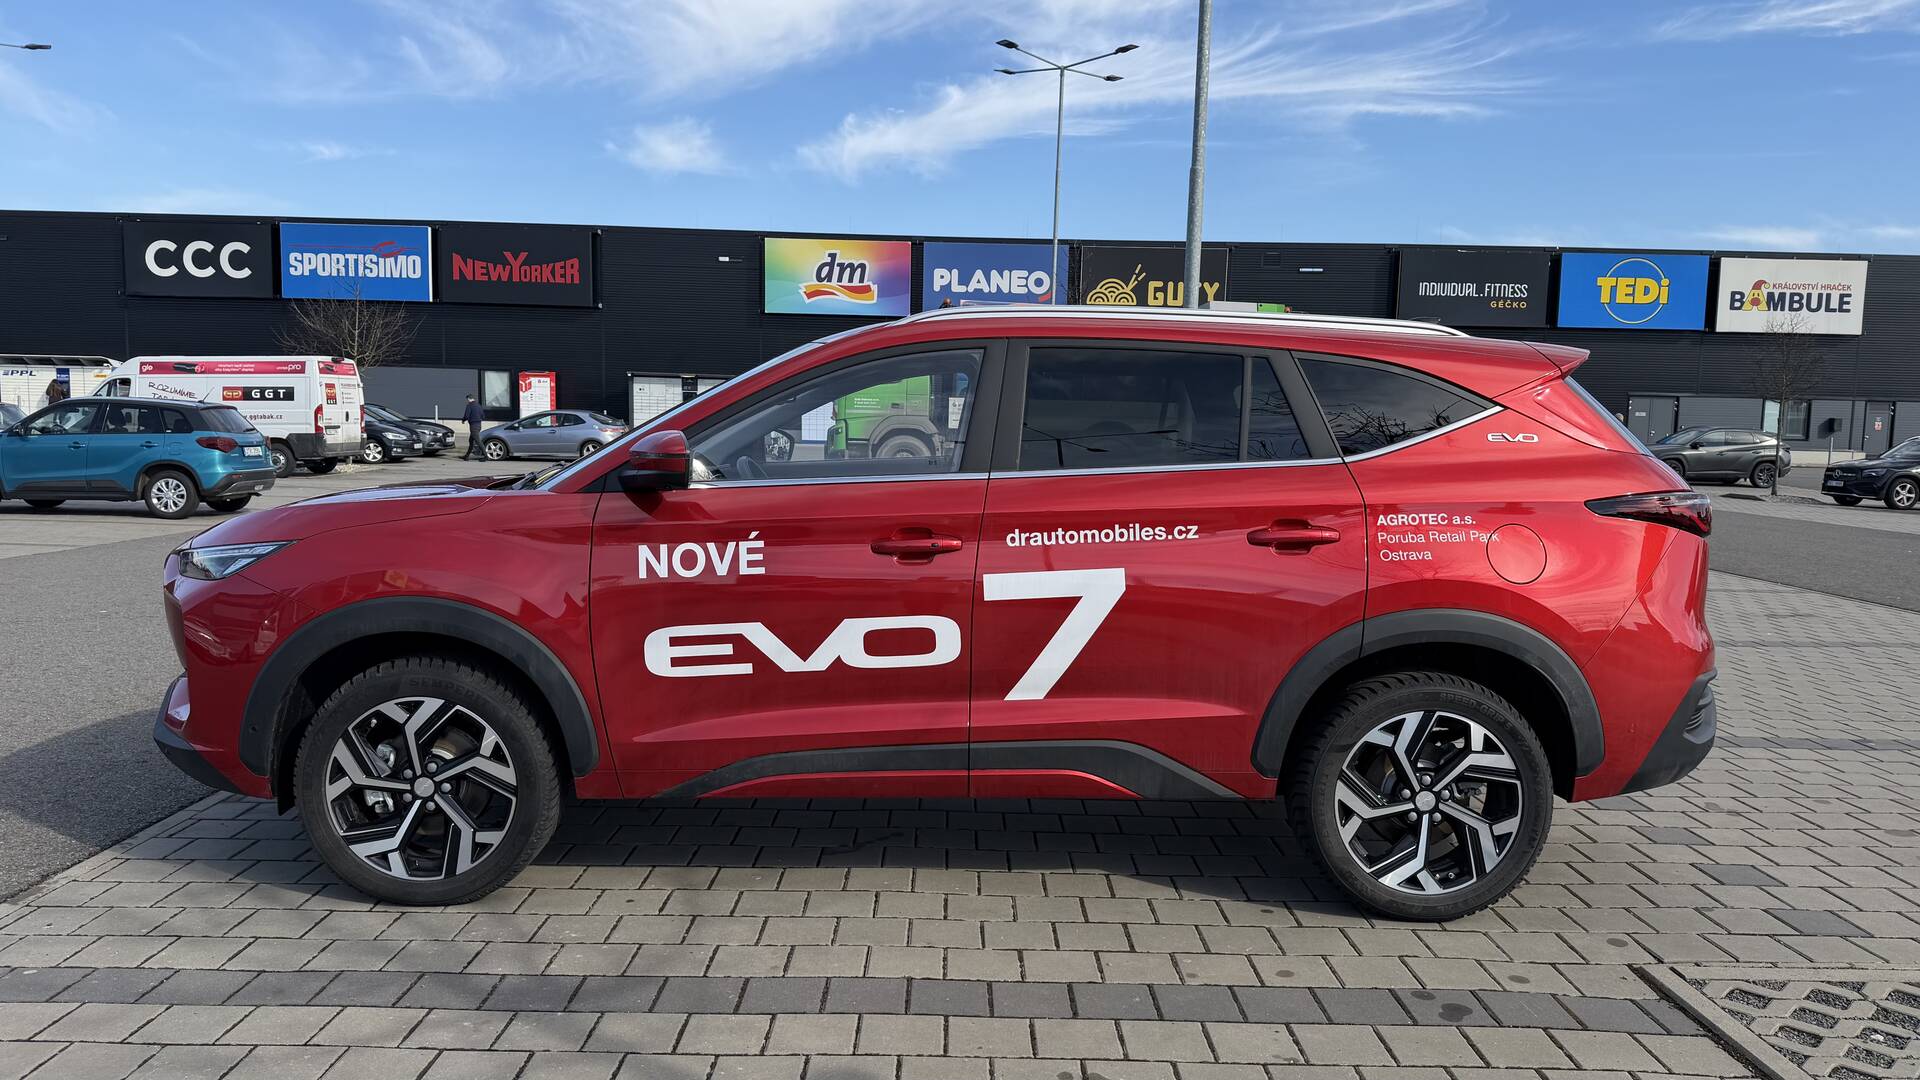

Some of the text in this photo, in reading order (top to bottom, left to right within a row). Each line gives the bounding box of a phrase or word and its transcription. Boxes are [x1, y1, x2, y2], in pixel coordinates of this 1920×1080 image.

[145, 239, 252, 279] CCC
[289, 252, 422, 279] SPORTISIMO
[815, 252, 867, 283] dm
[933, 268, 1051, 294] PLANEO
[1147, 280, 1220, 306] GUY
[1597, 277, 1670, 304] TEDi
[1772, 282, 1852, 292] KRÁLOVSTVÍ HRAČEK
[1490, 299, 1527, 309] GÉČKO
[1729, 288, 1852, 313] BAMBULE
[11, 369, 37, 377] PPL
[251, 389, 287, 399] GGT
[1487, 432, 1539, 443] EVO
[1377, 513, 1476, 526] AGROTEC a.s.
[1006, 523, 1199, 547] drautomobiles.cz
[1377, 530, 1500, 544] Poruba Retail Park
[637, 531, 766, 579] NOVÉ
[1380, 549, 1432, 562] Ostrava
[644, 567, 1126, 701] EVO 7
